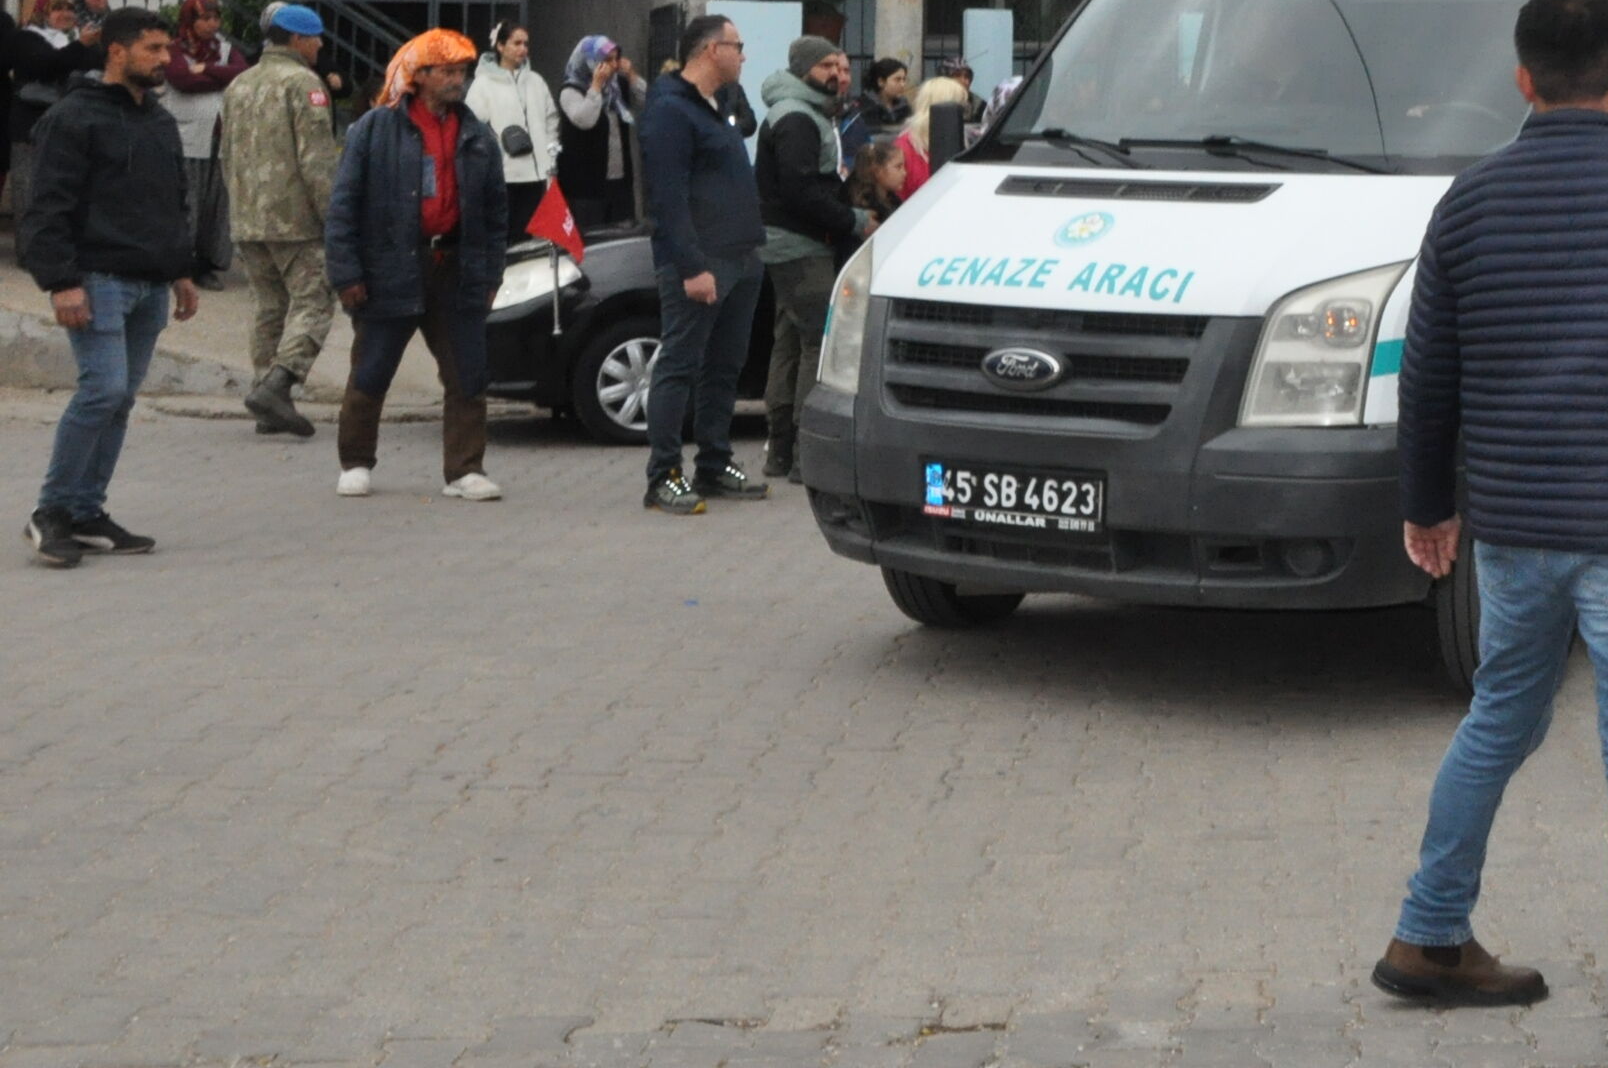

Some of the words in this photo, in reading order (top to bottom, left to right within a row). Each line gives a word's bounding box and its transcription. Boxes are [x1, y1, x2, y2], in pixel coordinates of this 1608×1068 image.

[918, 257, 1060, 288] CENAZE
[1068, 262, 1195, 303] ARACI
[996, 354, 1040, 379] Ford
[943, 470, 972, 504] 45
[983, 473, 1017, 507] SB
[1024, 478, 1095, 515] 4623
